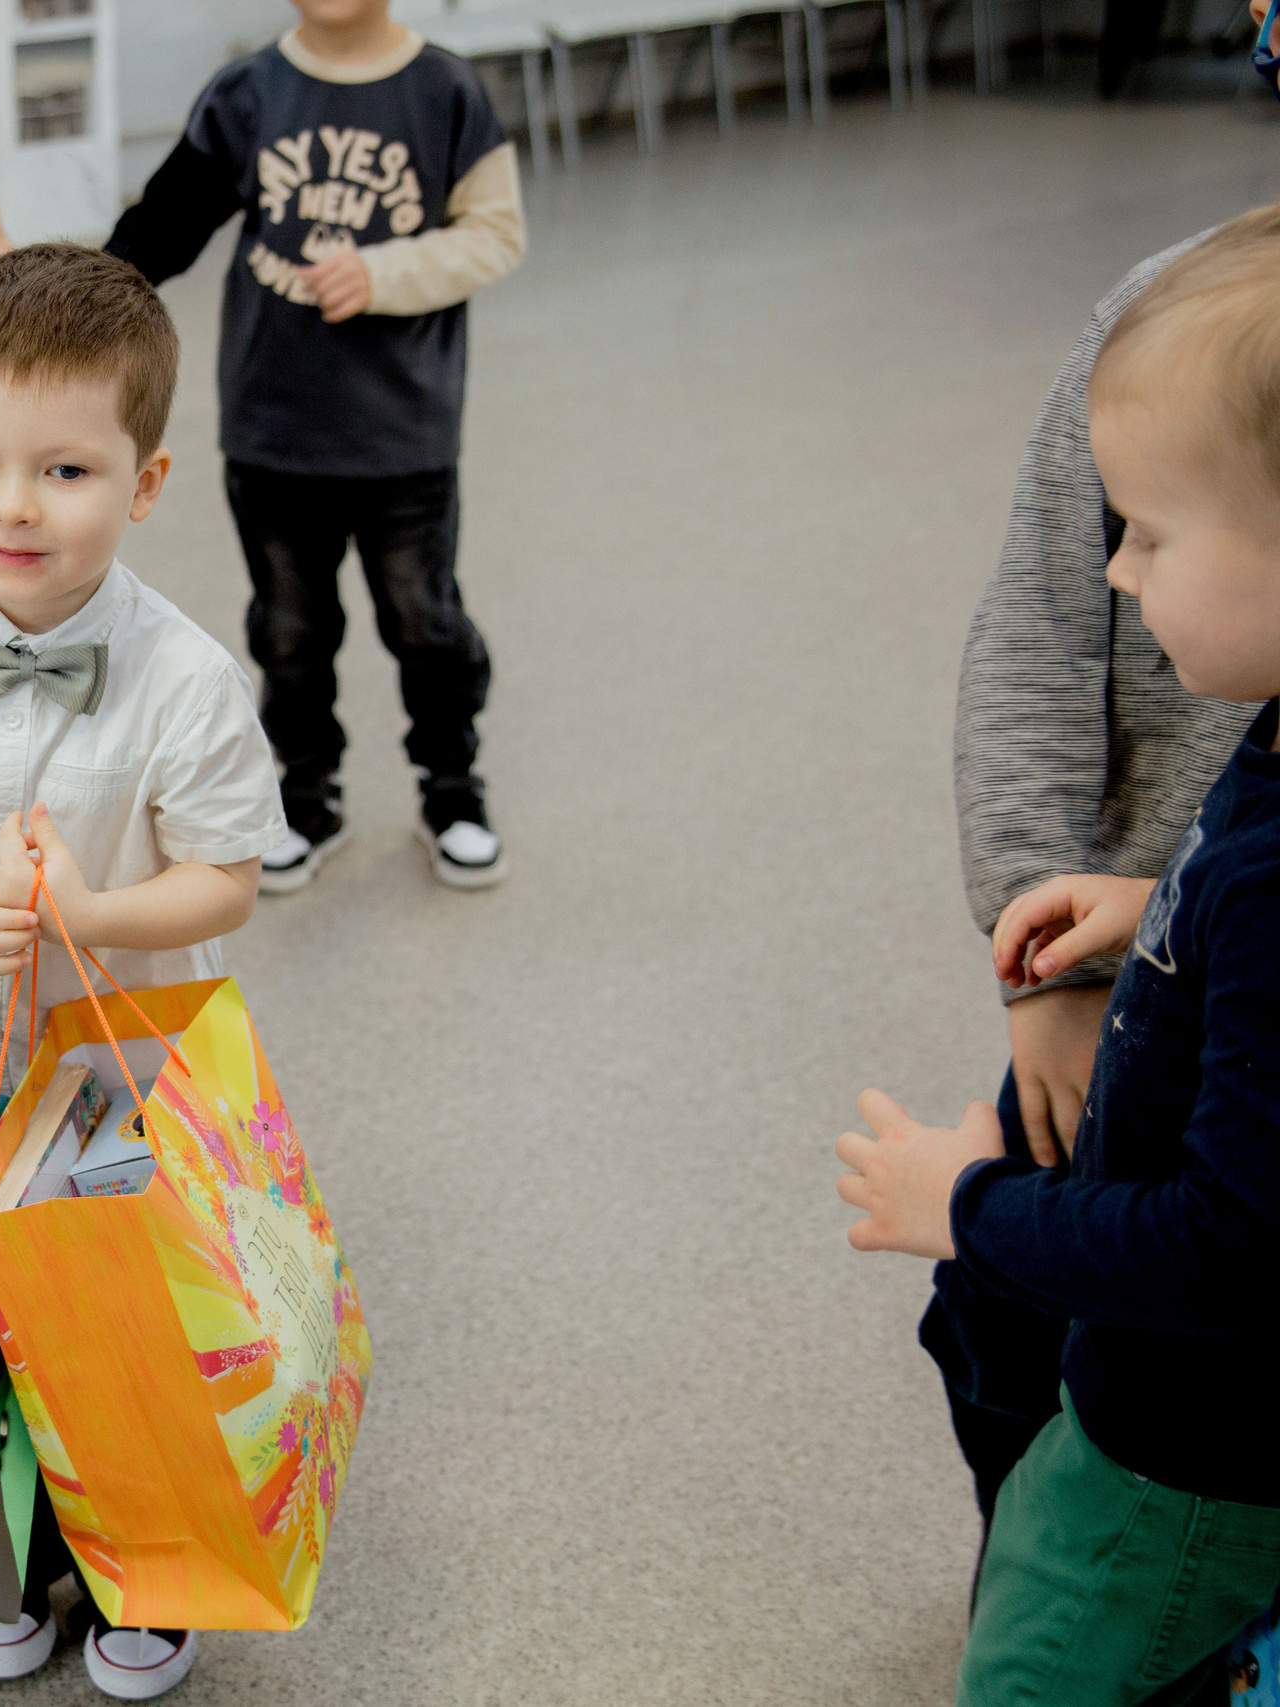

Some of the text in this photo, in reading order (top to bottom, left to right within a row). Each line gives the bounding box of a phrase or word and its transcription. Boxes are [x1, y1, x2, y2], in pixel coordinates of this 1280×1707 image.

[297, 181, 378, 231] NEW
[318, 125, 409, 193] YES
[381, 167, 424, 236] TO
[86, 1177, 129, 1193] СИНИЙ
[247, 1215, 282, 1275] ЭТО
[273, 1241, 311, 1318] ТВОЙ
[301, 1287, 331, 1371] ДЕНЬ
